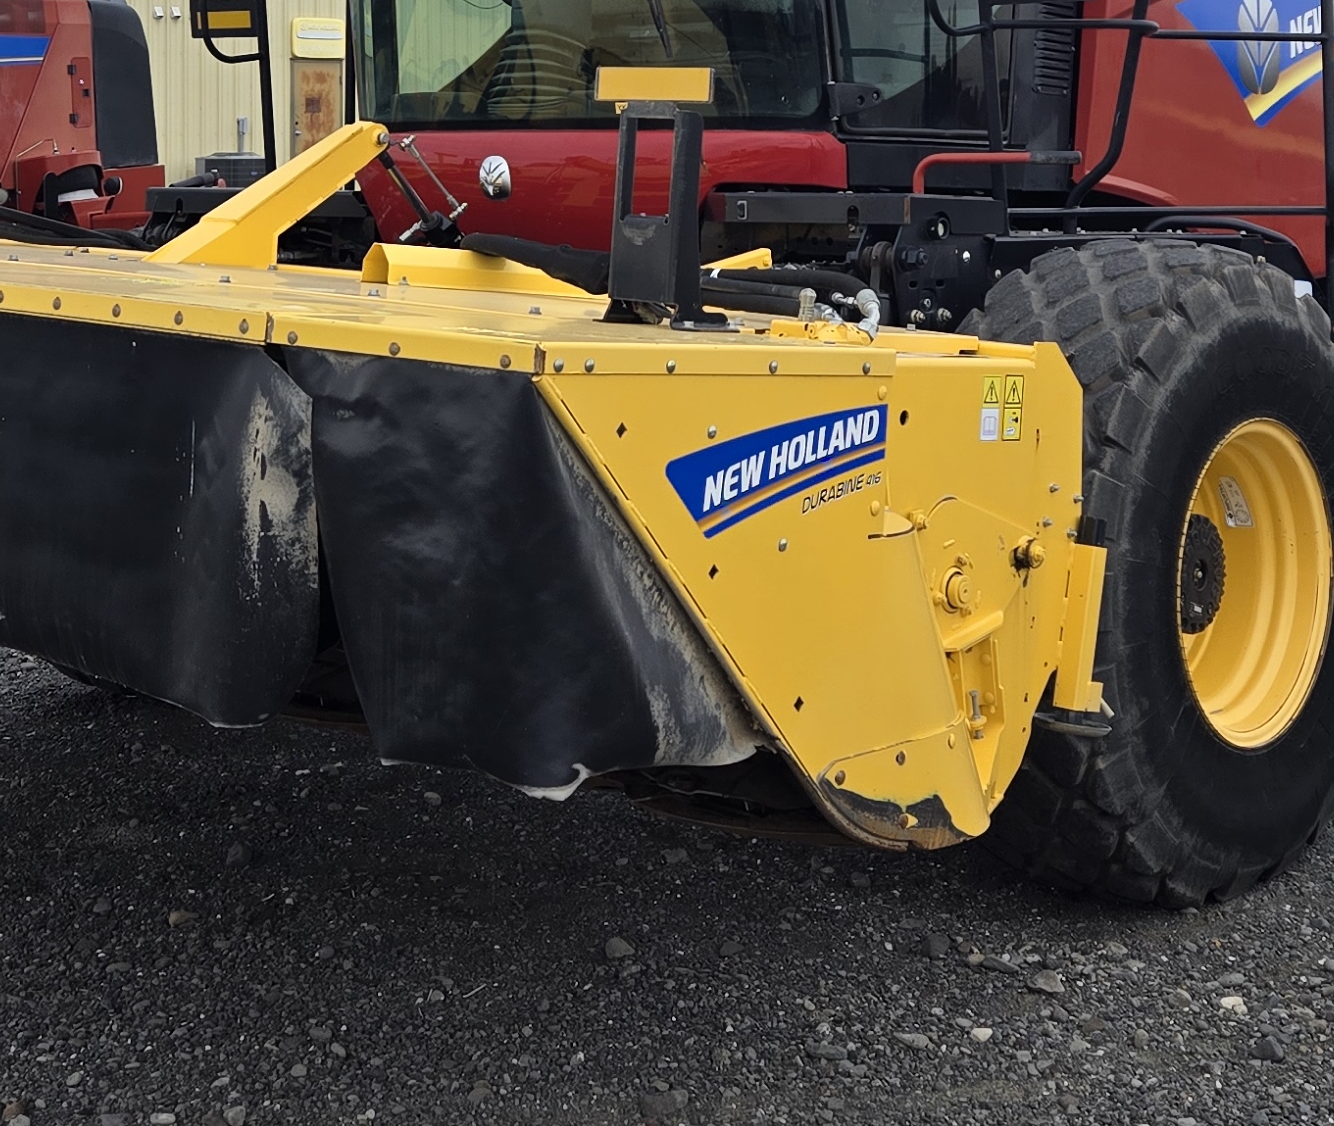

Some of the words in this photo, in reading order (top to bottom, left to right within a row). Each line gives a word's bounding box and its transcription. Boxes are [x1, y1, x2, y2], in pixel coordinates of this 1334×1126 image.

[703, 450, 765, 512] NEW
[768, 409, 880, 480] HOLLAND
[801, 473, 865, 515] DURABINE
[866, 471, 881, 486] 416
